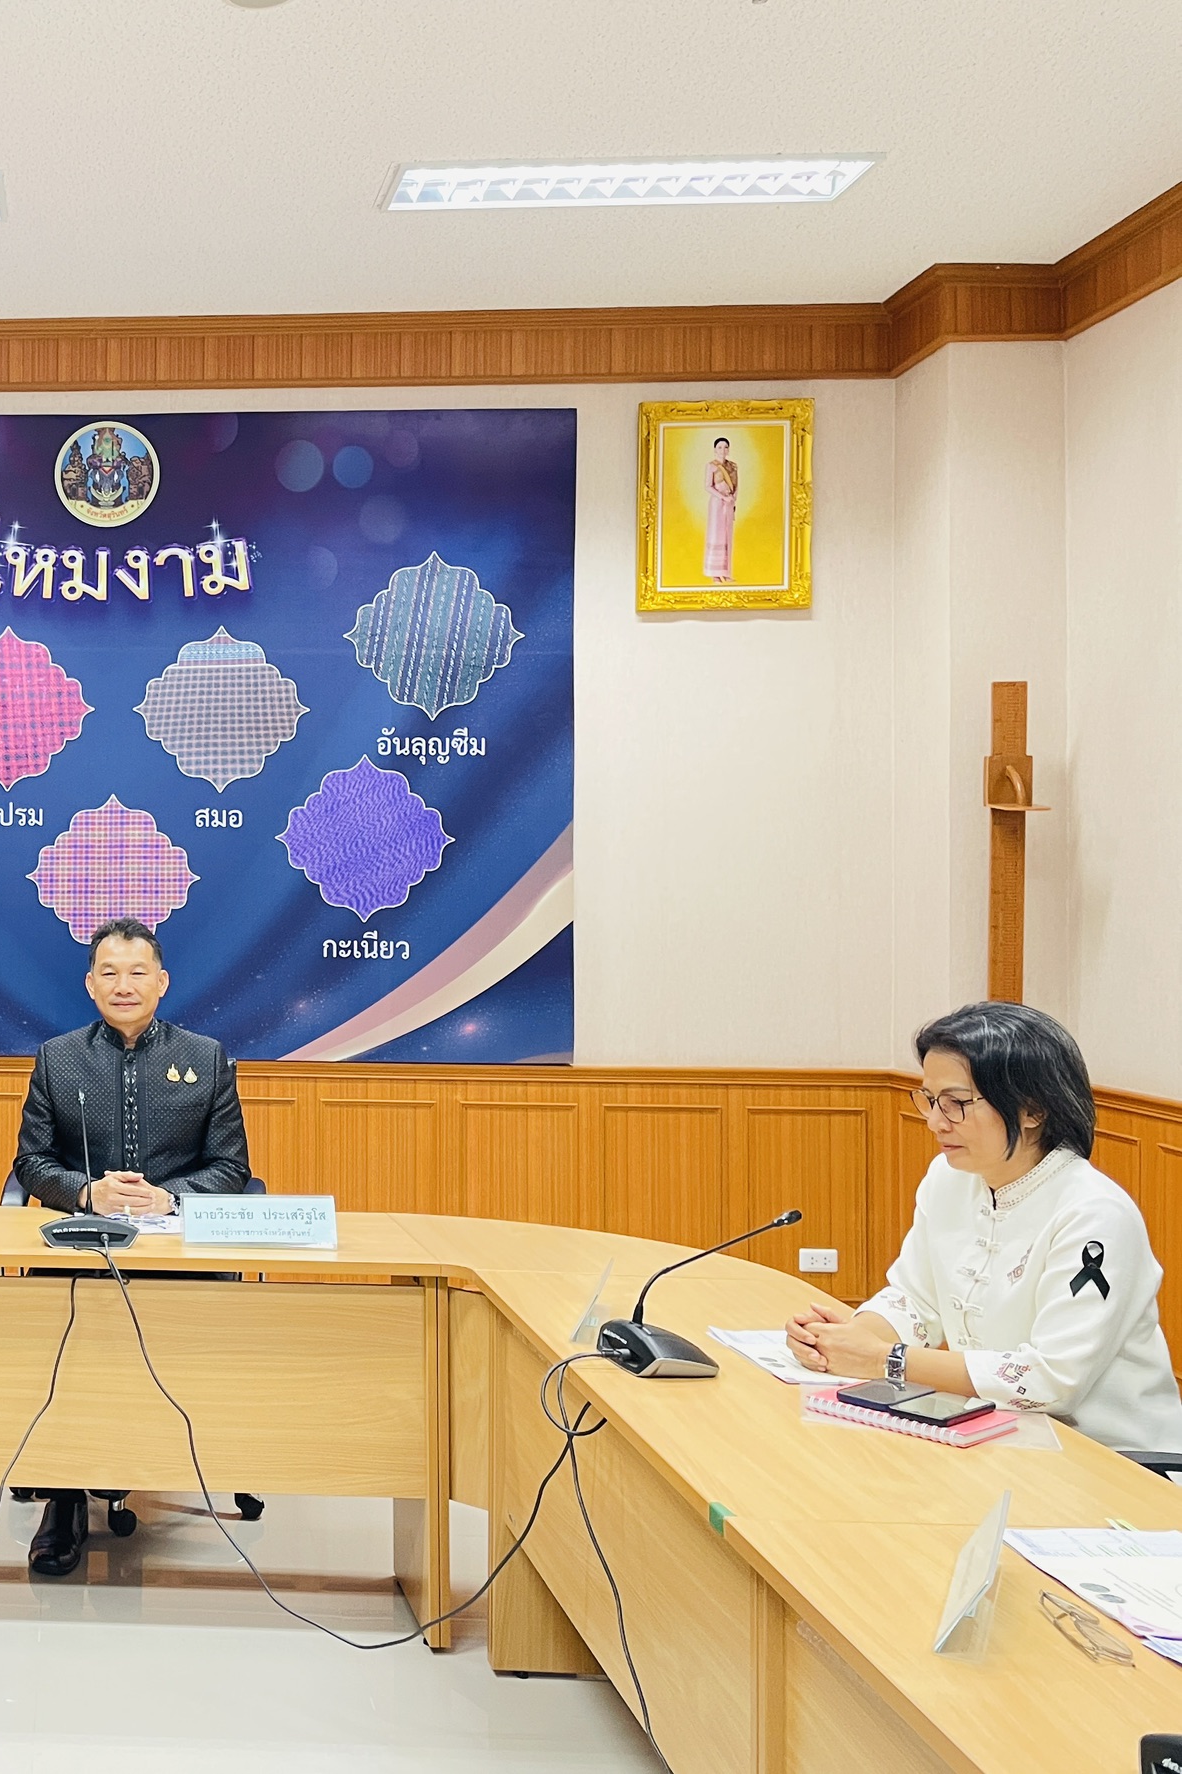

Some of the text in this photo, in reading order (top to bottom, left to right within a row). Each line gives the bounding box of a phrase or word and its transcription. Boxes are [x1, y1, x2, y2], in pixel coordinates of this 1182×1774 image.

[376, 726, 487, 765] อันลุญซีม
[194, 807, 244, 828] สมอ
[322, 930, 411, 960] กะเนียว
[194, 1207, 254, 1220] นายวีระชัย
